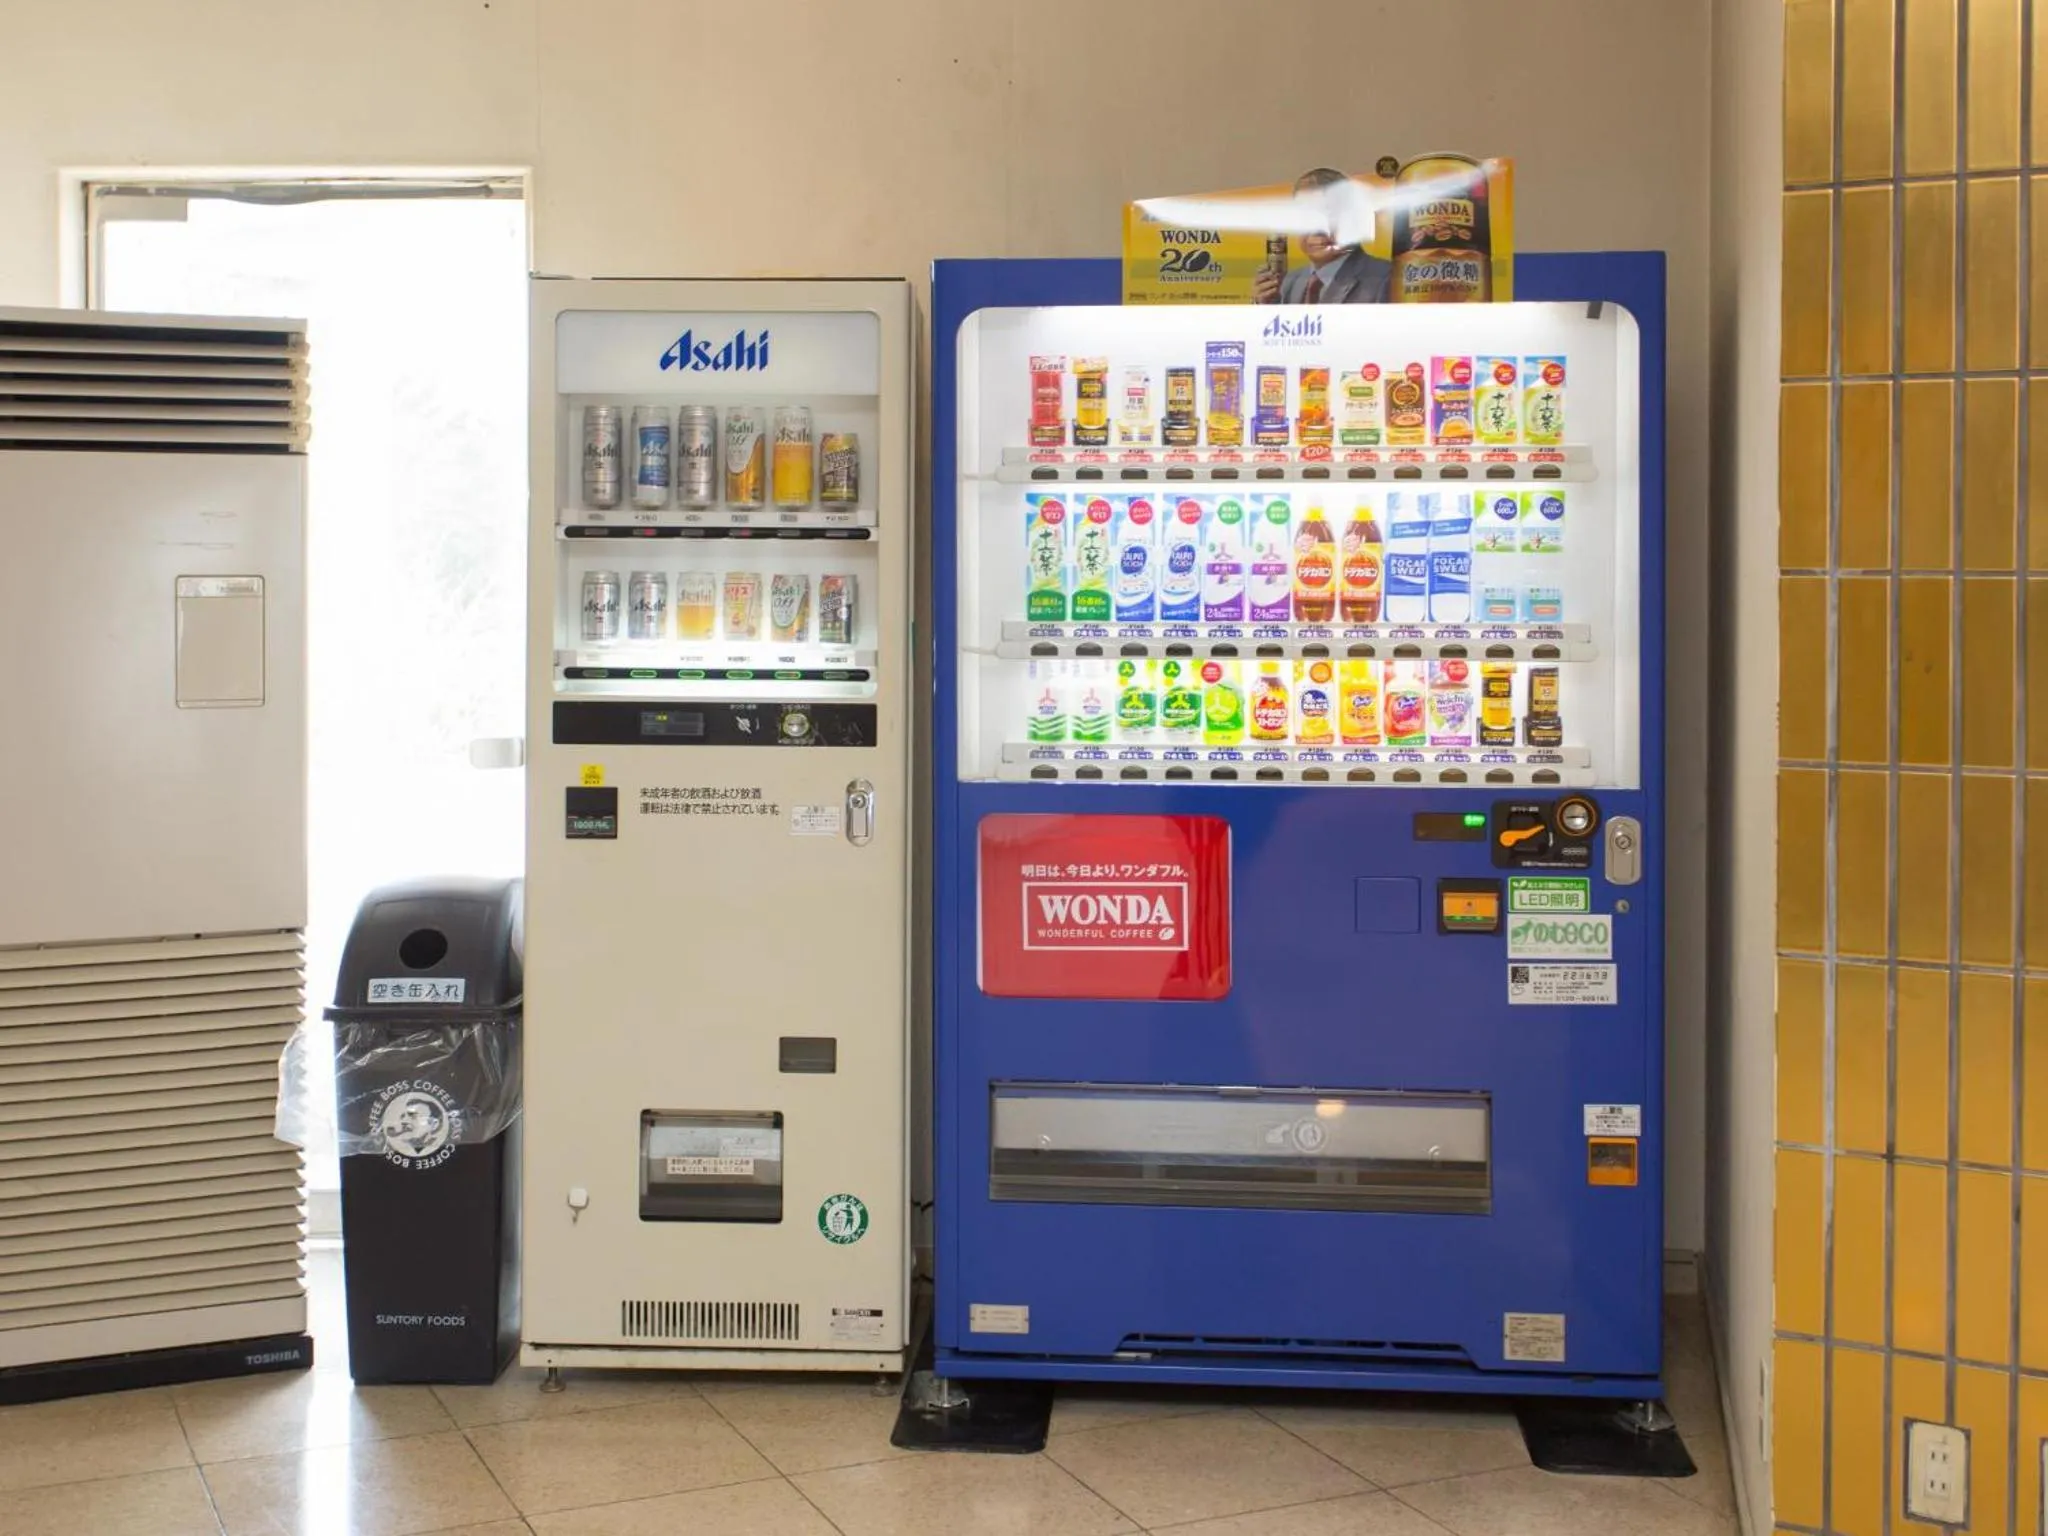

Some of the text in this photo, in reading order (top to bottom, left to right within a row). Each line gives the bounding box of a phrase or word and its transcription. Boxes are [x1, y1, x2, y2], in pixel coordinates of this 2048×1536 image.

[1414, 202, 1471, 216] WONDA
[1160, 230, 1221, 244] WONDA
[1405, 260, 1478, 282] 金の微糖
[1160, 275, 1222, 283] Anniversary
[1263, 313, 1322, 337] Asahi
[659, 329, 770, 371] Asahi
[1391, 559, 1426, 568] POCAR
[1434, 557, 1470, 567] POCAR
[640, 787, 762, 799] 未成年者の飲酒および飲酒
[640, 802, 780, 816] 運転は法律で禁止されています。
[1519, 893, 1581, 907] LED照明
[1038, 895, 1174, 925] WONDA
[1037, 929, 1153, 938] WONDERFUL COFFEE
[371, 983, 459, 1000] 空き缶入れ
[380, 1080, 410, 1101] BOSS
[413, 1079, 456, 1108] COFFEE
[384, 1149, 410, 1169] BOS
[416, 1143, 456, 1170] COFFEE
[376, 1315, 466, 1326] SUNTORY FOODS
[245, 1349, 300, 1365] TOSHIBA
